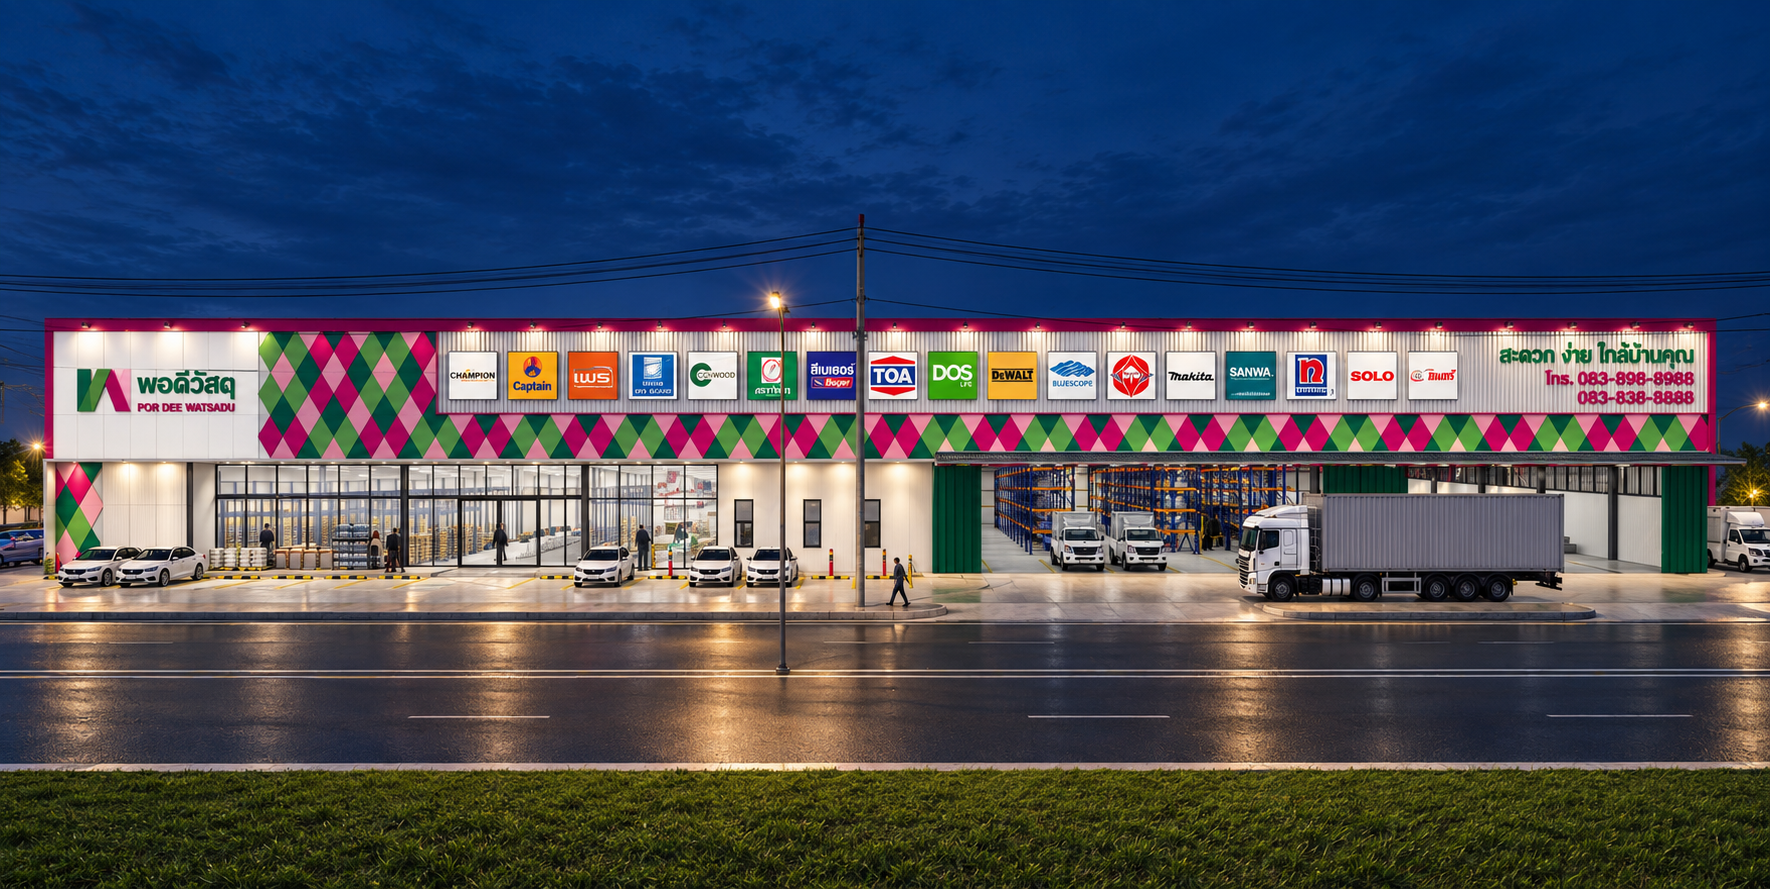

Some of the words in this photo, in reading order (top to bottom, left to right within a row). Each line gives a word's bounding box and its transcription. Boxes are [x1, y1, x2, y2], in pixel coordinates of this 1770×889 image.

[1499, 347, 1555, 364] สะดวก
[1561, 341, 1593, 364] ง่าย
[1597, 341, 1694, 369] ใกล้บ้านคุณ
[449, 371, 496, 380] CHAMPION
[873, 367, 913, 384] TOA
[932, 364, 973, 381] DOS
[1350, 370, 1395, 382] SOLO
[1577, 371, 1694, 387] 083-898-8988
[137, 370, 236, 400] พอดีวัสดุ
[513, 381, 552, 393] Captain
[1577, 390, 1694, 405] 083-838-8888
[137, 403, 160, 412] POR
[162, 403, 183, 412] DEE
[185, 403, 236, 412] WATSADU
